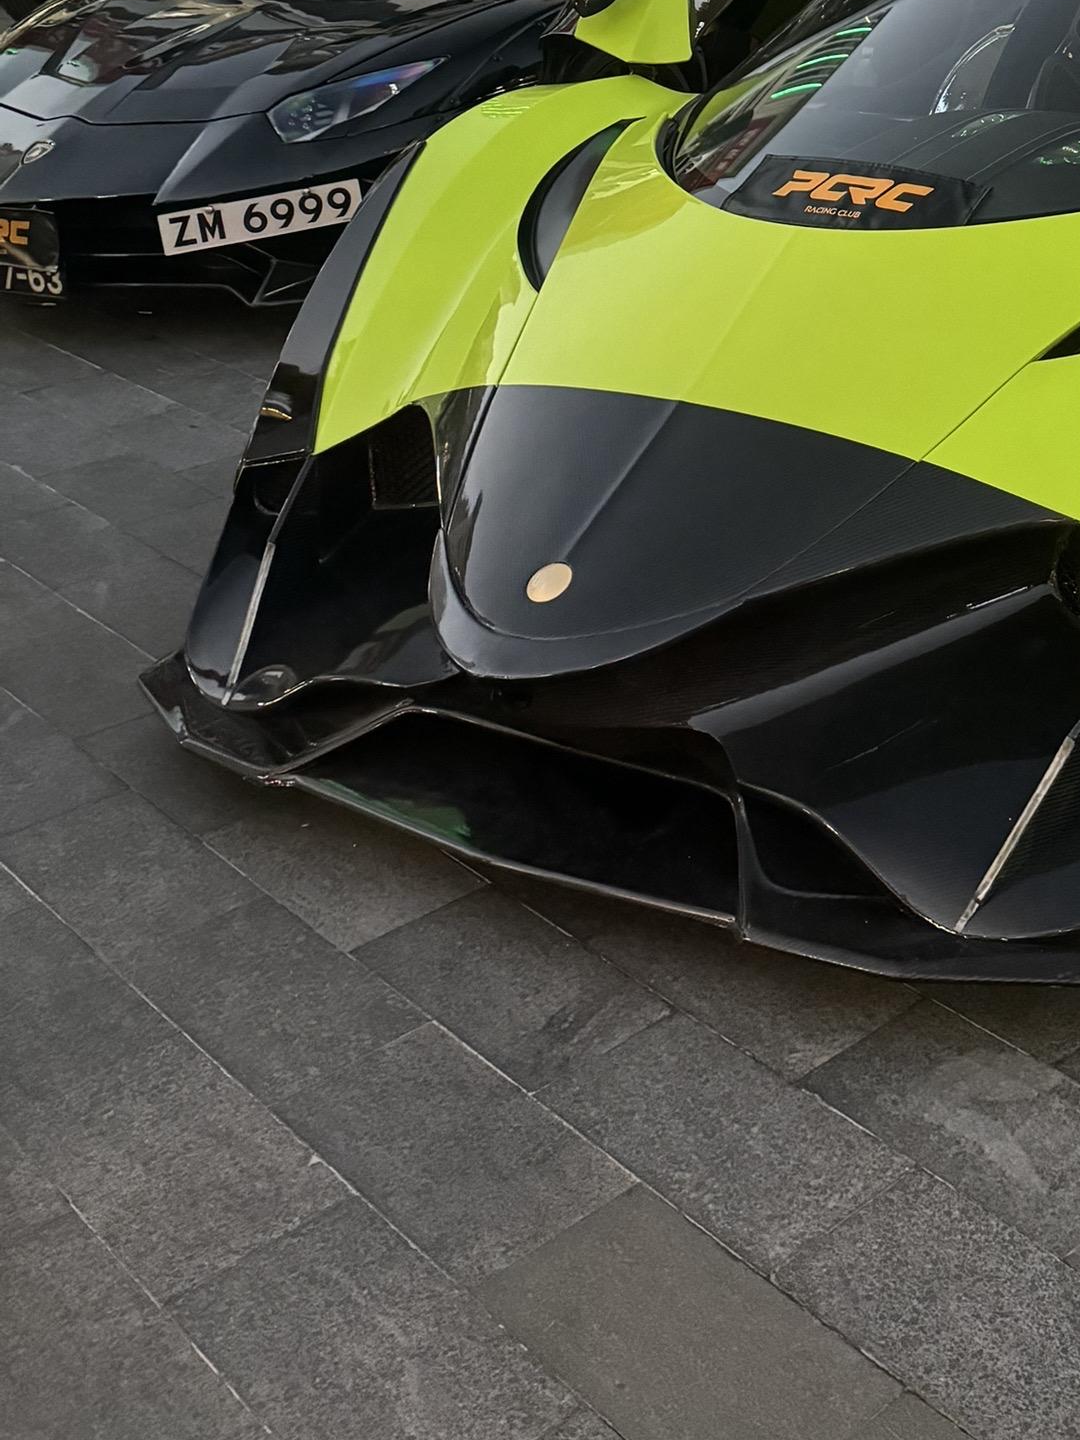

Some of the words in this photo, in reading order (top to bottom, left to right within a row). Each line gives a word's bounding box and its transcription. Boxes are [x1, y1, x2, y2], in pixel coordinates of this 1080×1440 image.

[772, 169, 935, 213] PCRC
[804, 204, 837, 217] RACING
[837, 208, 862, 219] CLUB
[168, 210, 227, 248] ZM
[243, 187, 352, 234] 6999
